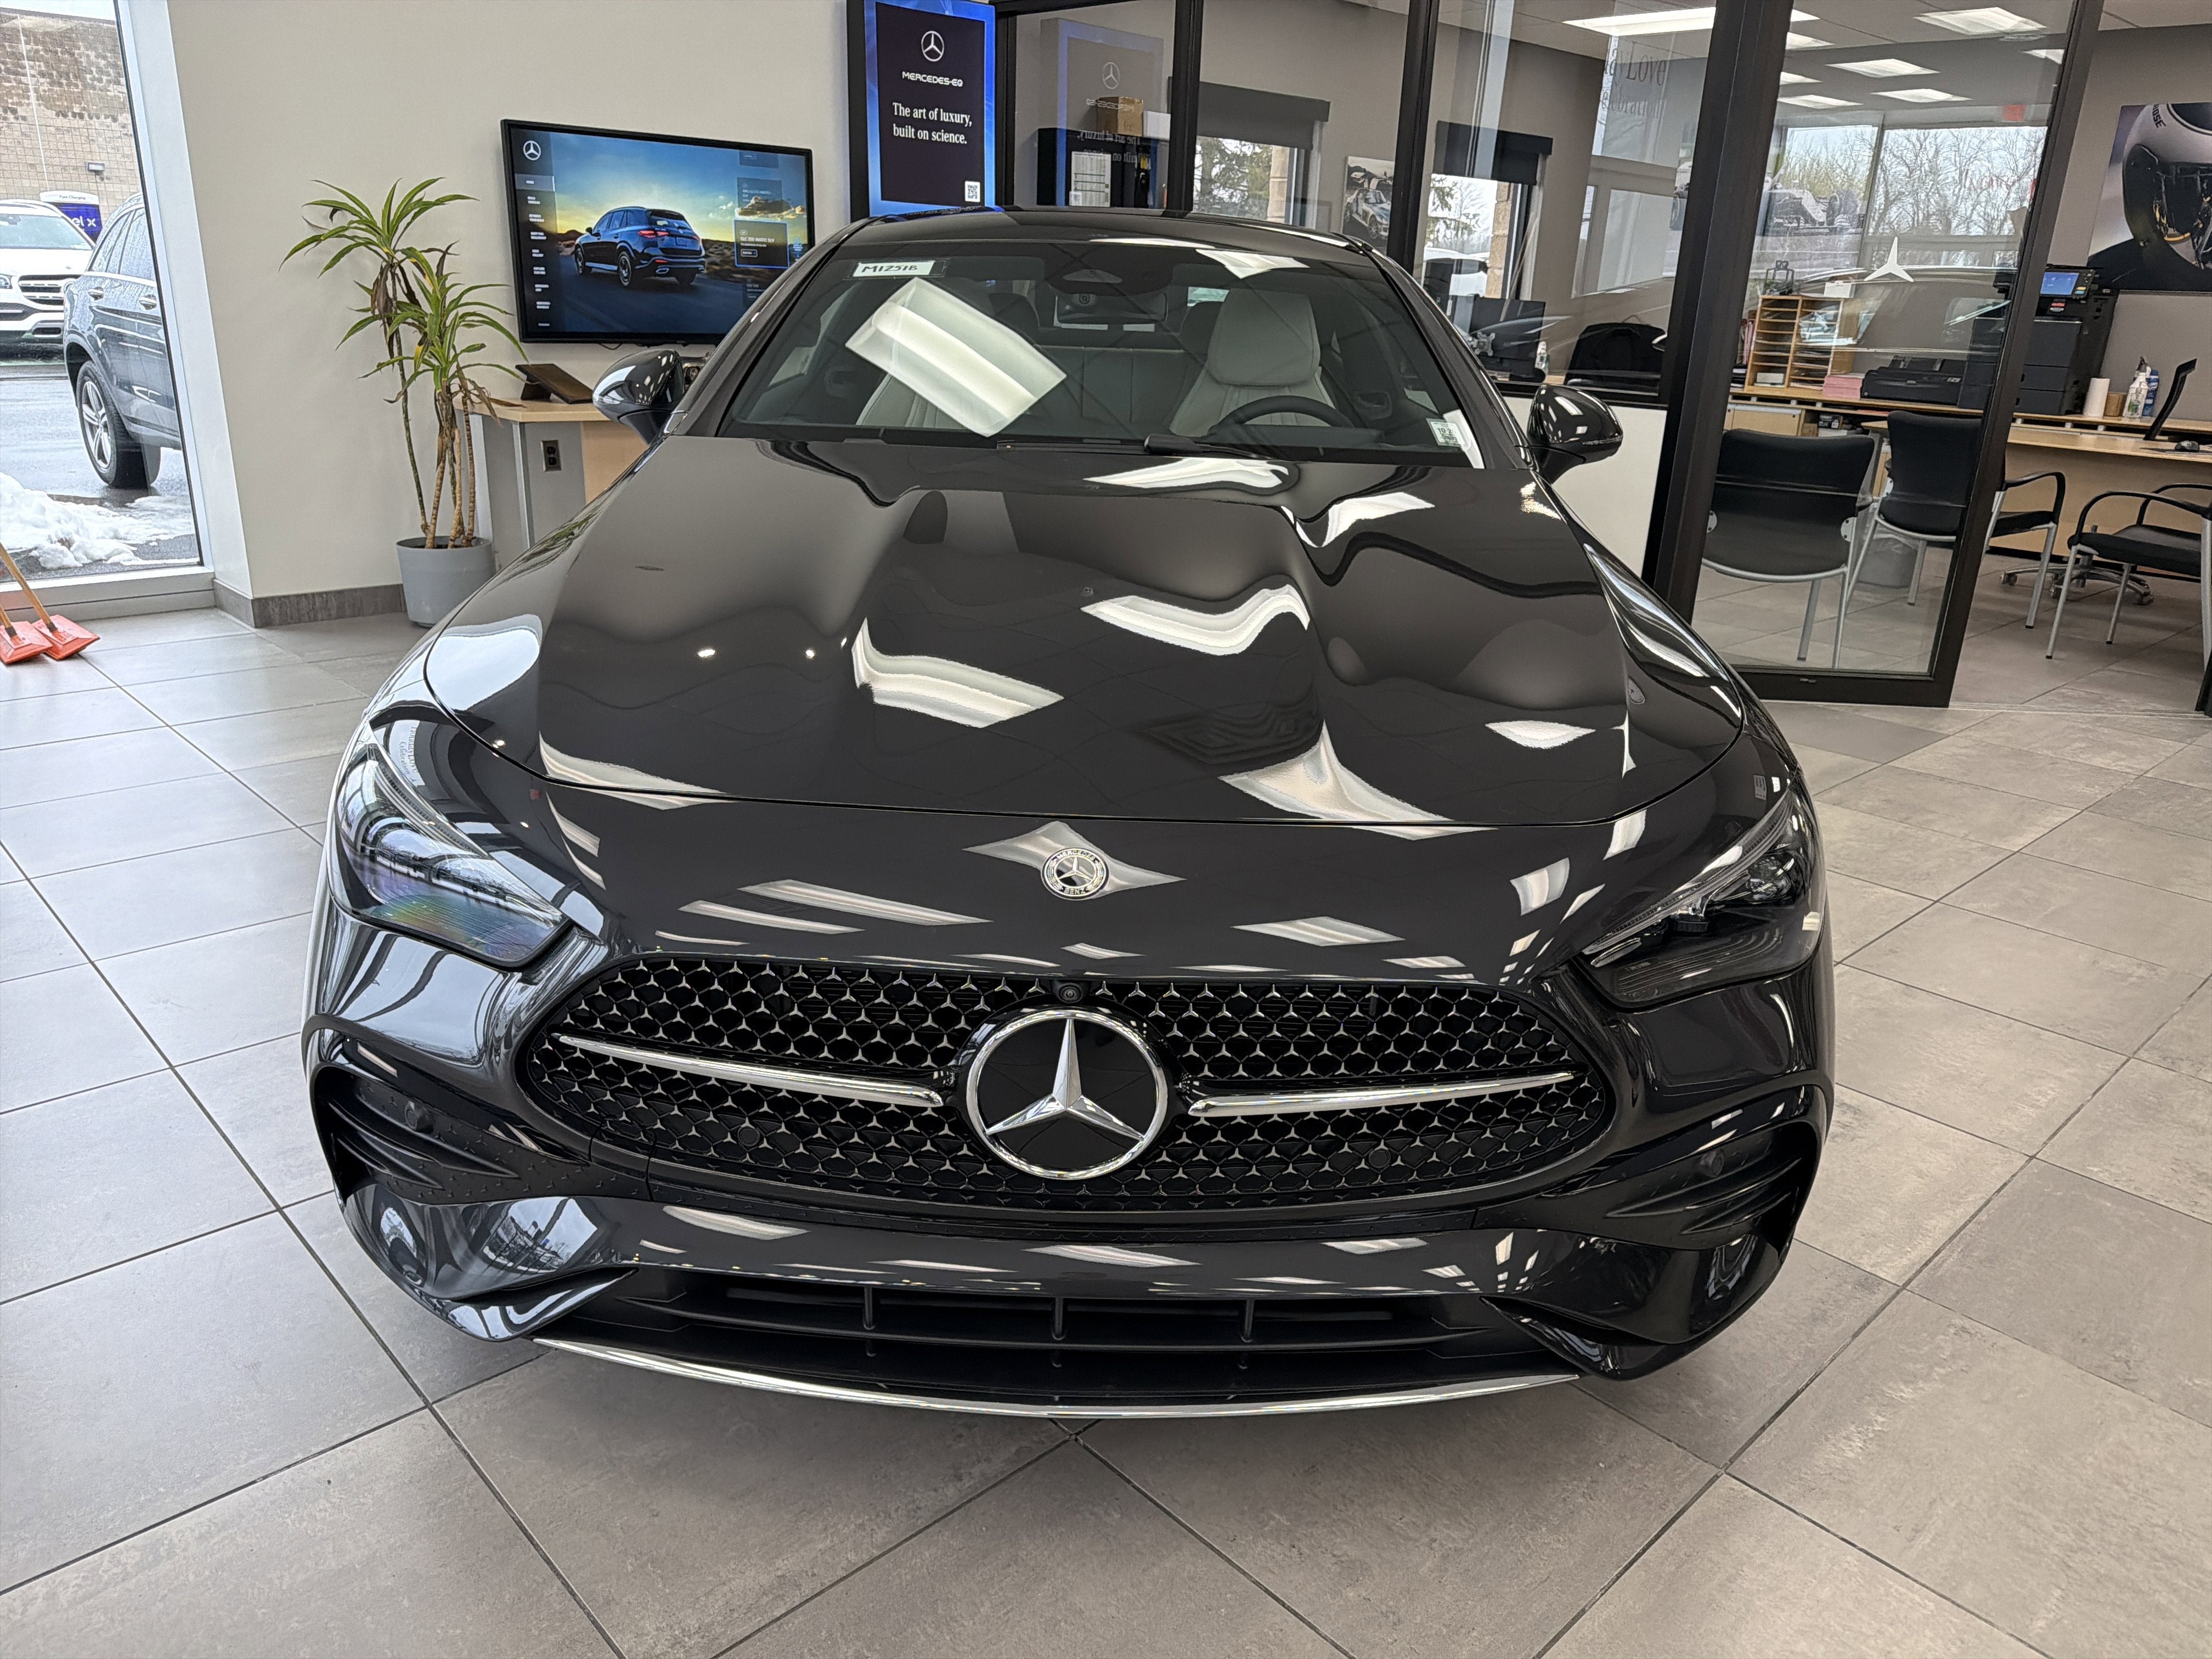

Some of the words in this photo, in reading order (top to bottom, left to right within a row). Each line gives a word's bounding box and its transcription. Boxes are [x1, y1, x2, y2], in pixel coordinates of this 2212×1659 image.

[902, 71, 963, 87] MERCEDES-EQ
[892, 102, 911, 117] The
[913, 108, 927, 120] art
[928, 108, 939, 121] of
[940, 108, 972, 127] luxury,
[892, 123, 916, 139] built
[917, 129, 929, 140] on
[931, 129, 967, 144] science.
[1056, 850, 1096, 861] MERCEDES
